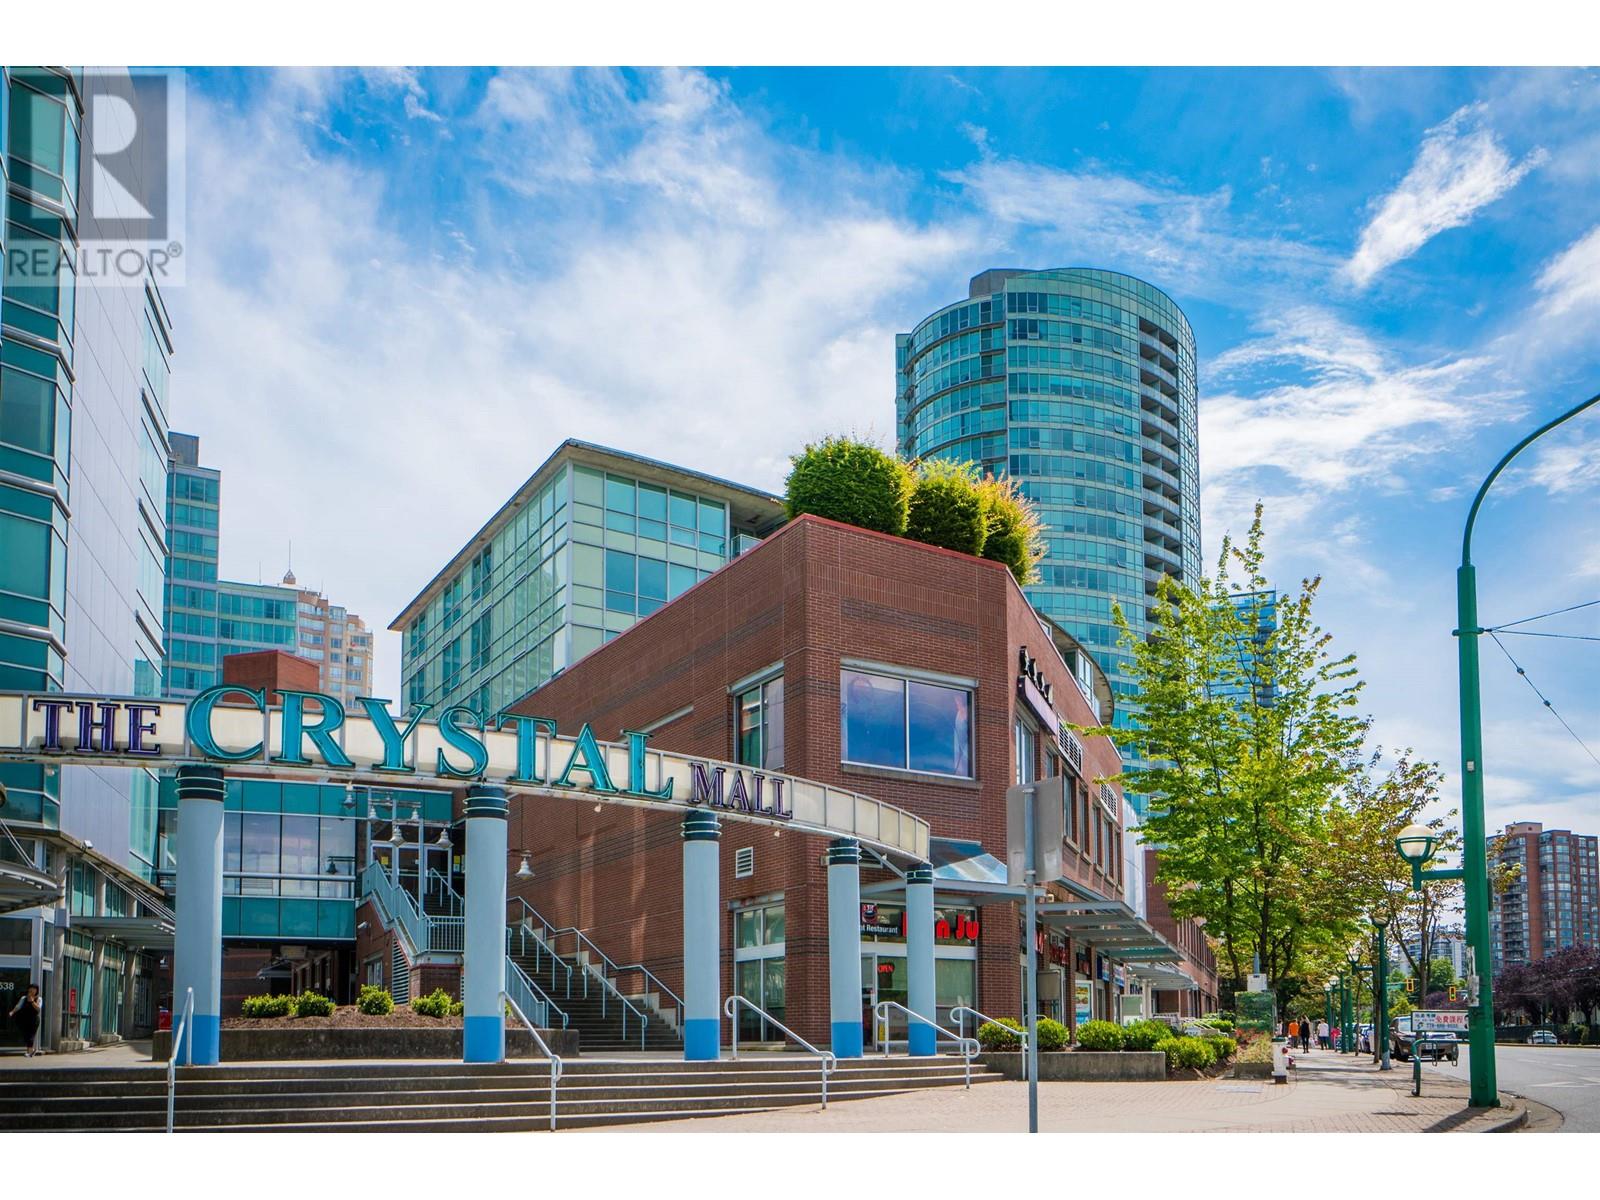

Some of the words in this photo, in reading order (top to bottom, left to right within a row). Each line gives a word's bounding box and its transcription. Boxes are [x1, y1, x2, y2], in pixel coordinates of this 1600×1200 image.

[33, 699, 161, 755] THE
[186, 684, 674, 800] CRYSTAL
[690, 760, 793, 819] MALL
[866, 923, 898, 934] Restaurant
